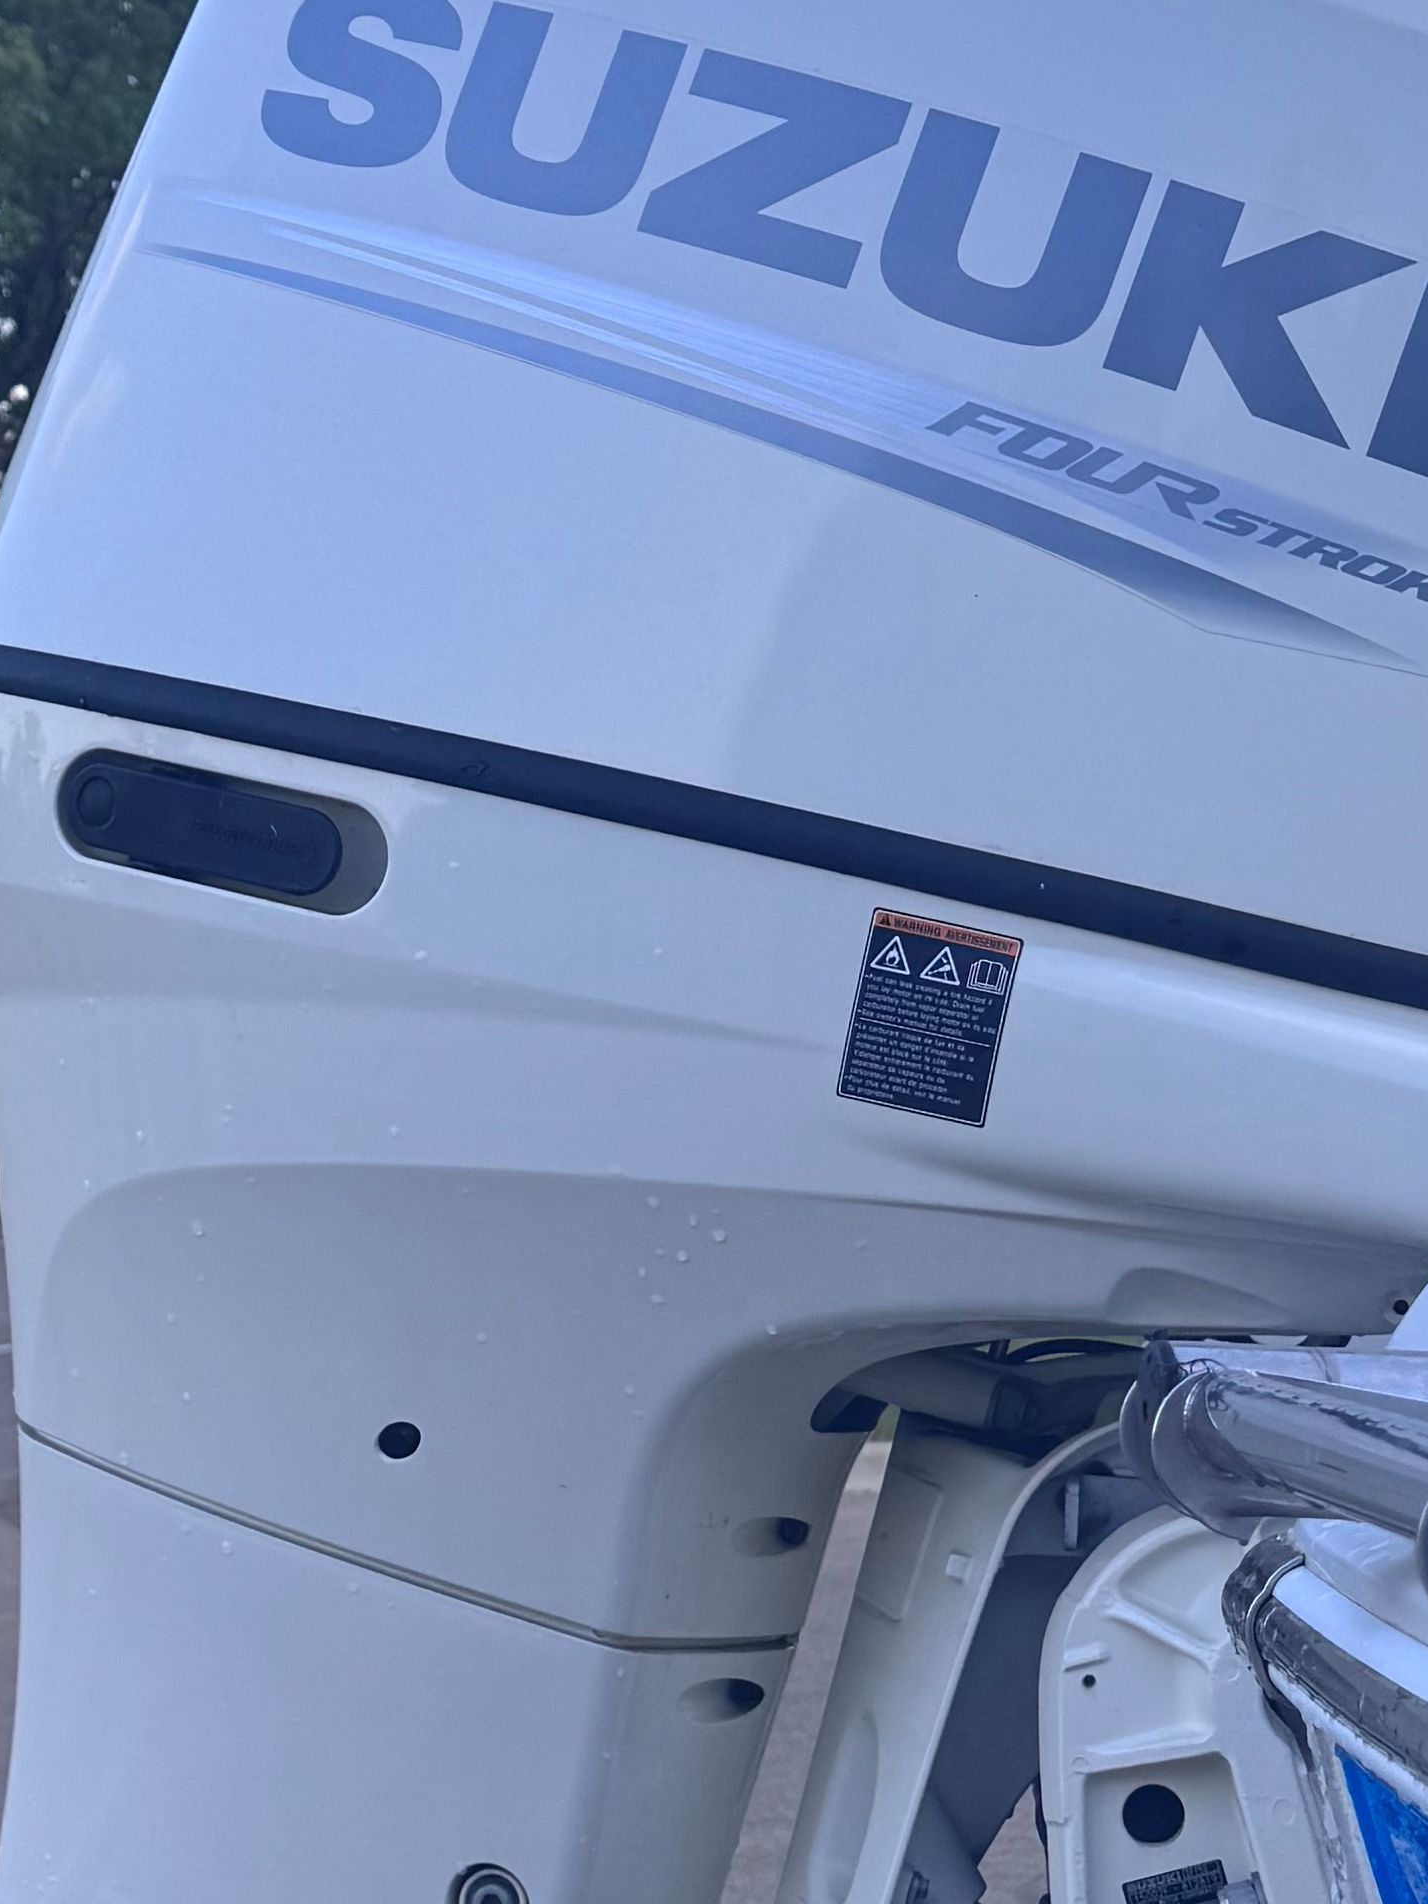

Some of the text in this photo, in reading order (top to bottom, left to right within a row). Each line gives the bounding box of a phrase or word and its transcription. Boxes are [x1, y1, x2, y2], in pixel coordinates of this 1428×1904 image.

[925, 400, 1221, 522] FOUR
[893, 916, 1012, 952] WARNING AVERTISSEMENT
